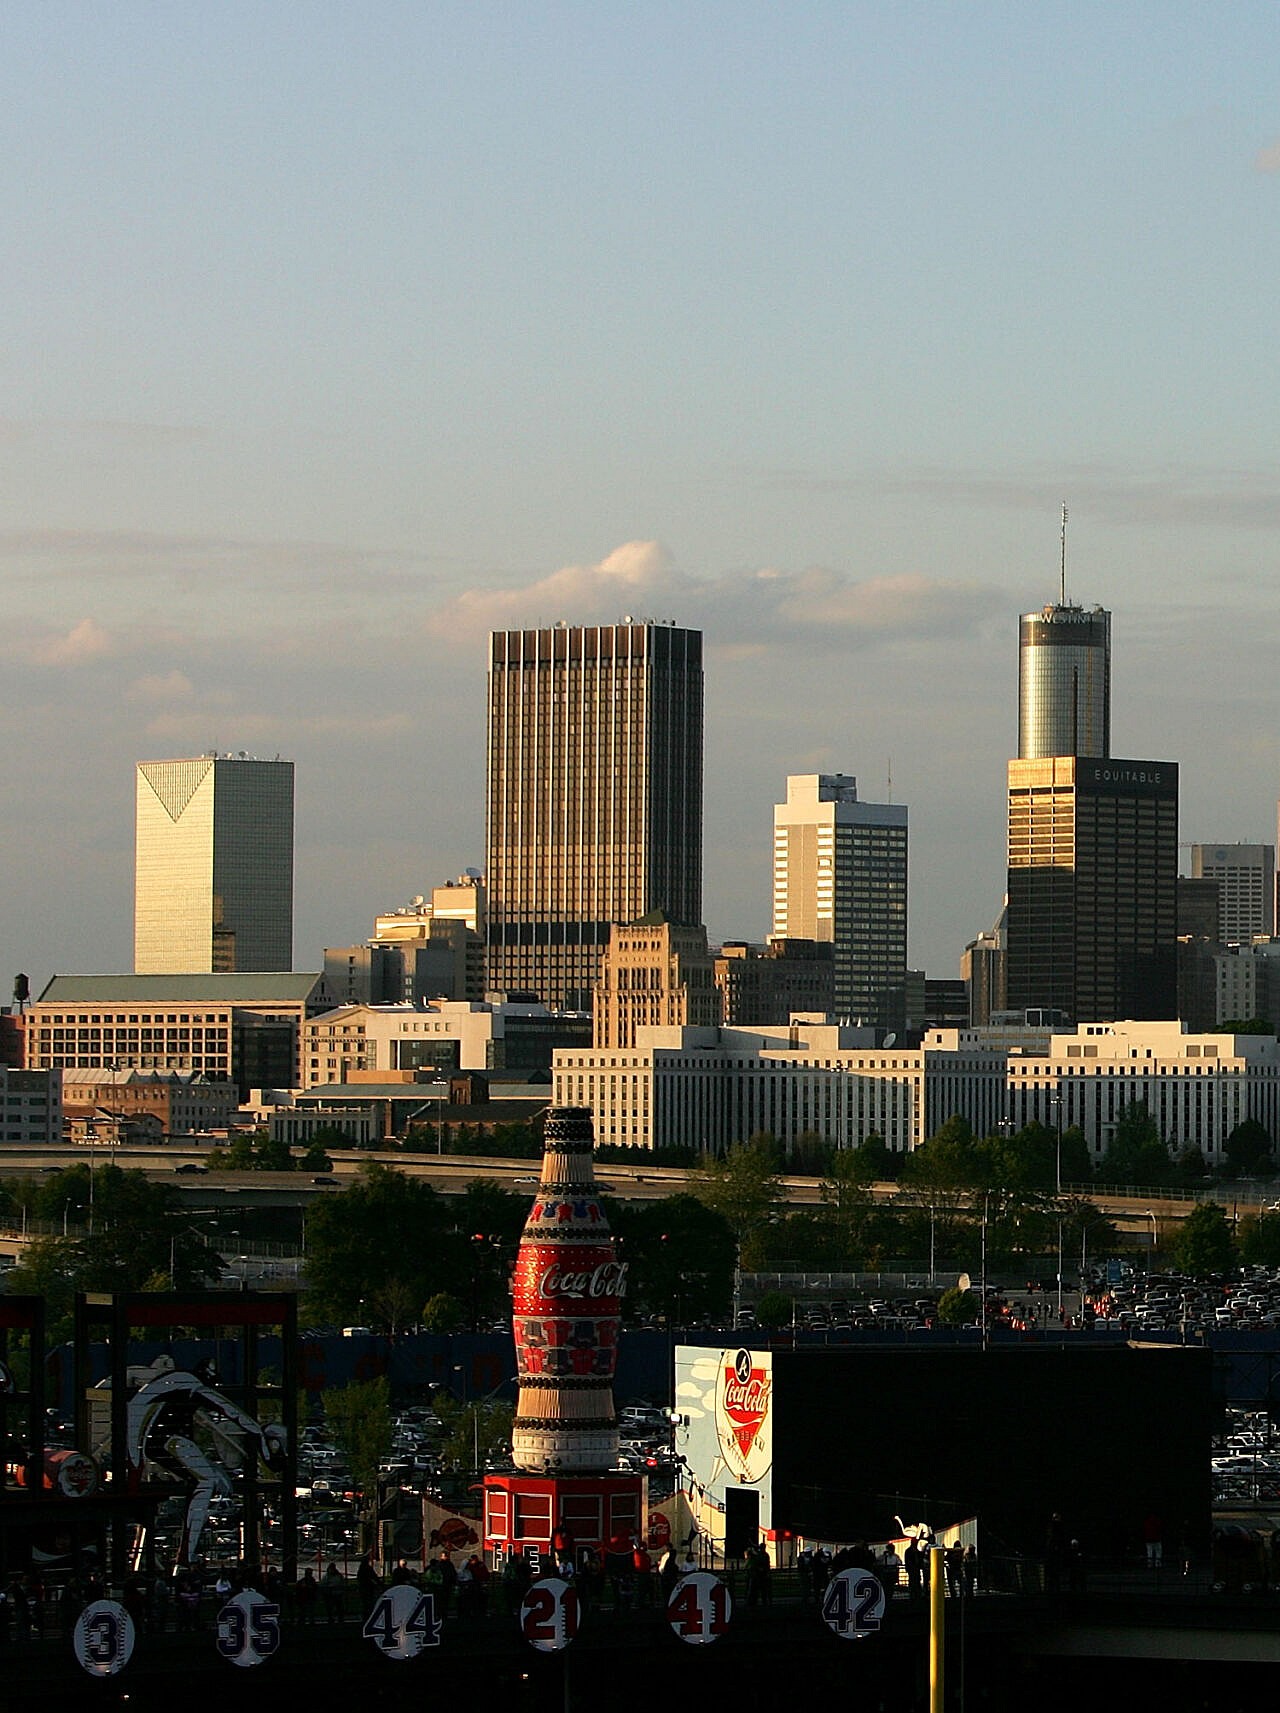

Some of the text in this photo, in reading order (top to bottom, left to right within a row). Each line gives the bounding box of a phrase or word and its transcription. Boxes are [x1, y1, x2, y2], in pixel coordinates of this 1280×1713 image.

[1094, 769, 1161, 784] EQUITABLE
[215, 1603, 281, 1658] 35
[362, 1593, 442, 1650] 44
[522, 1588, 578, 1640] 21
[663, 1583, 731, 1635] 41
[821, 1576, 883, 1633] 42
[86, 1612, 118, 1665] 3
